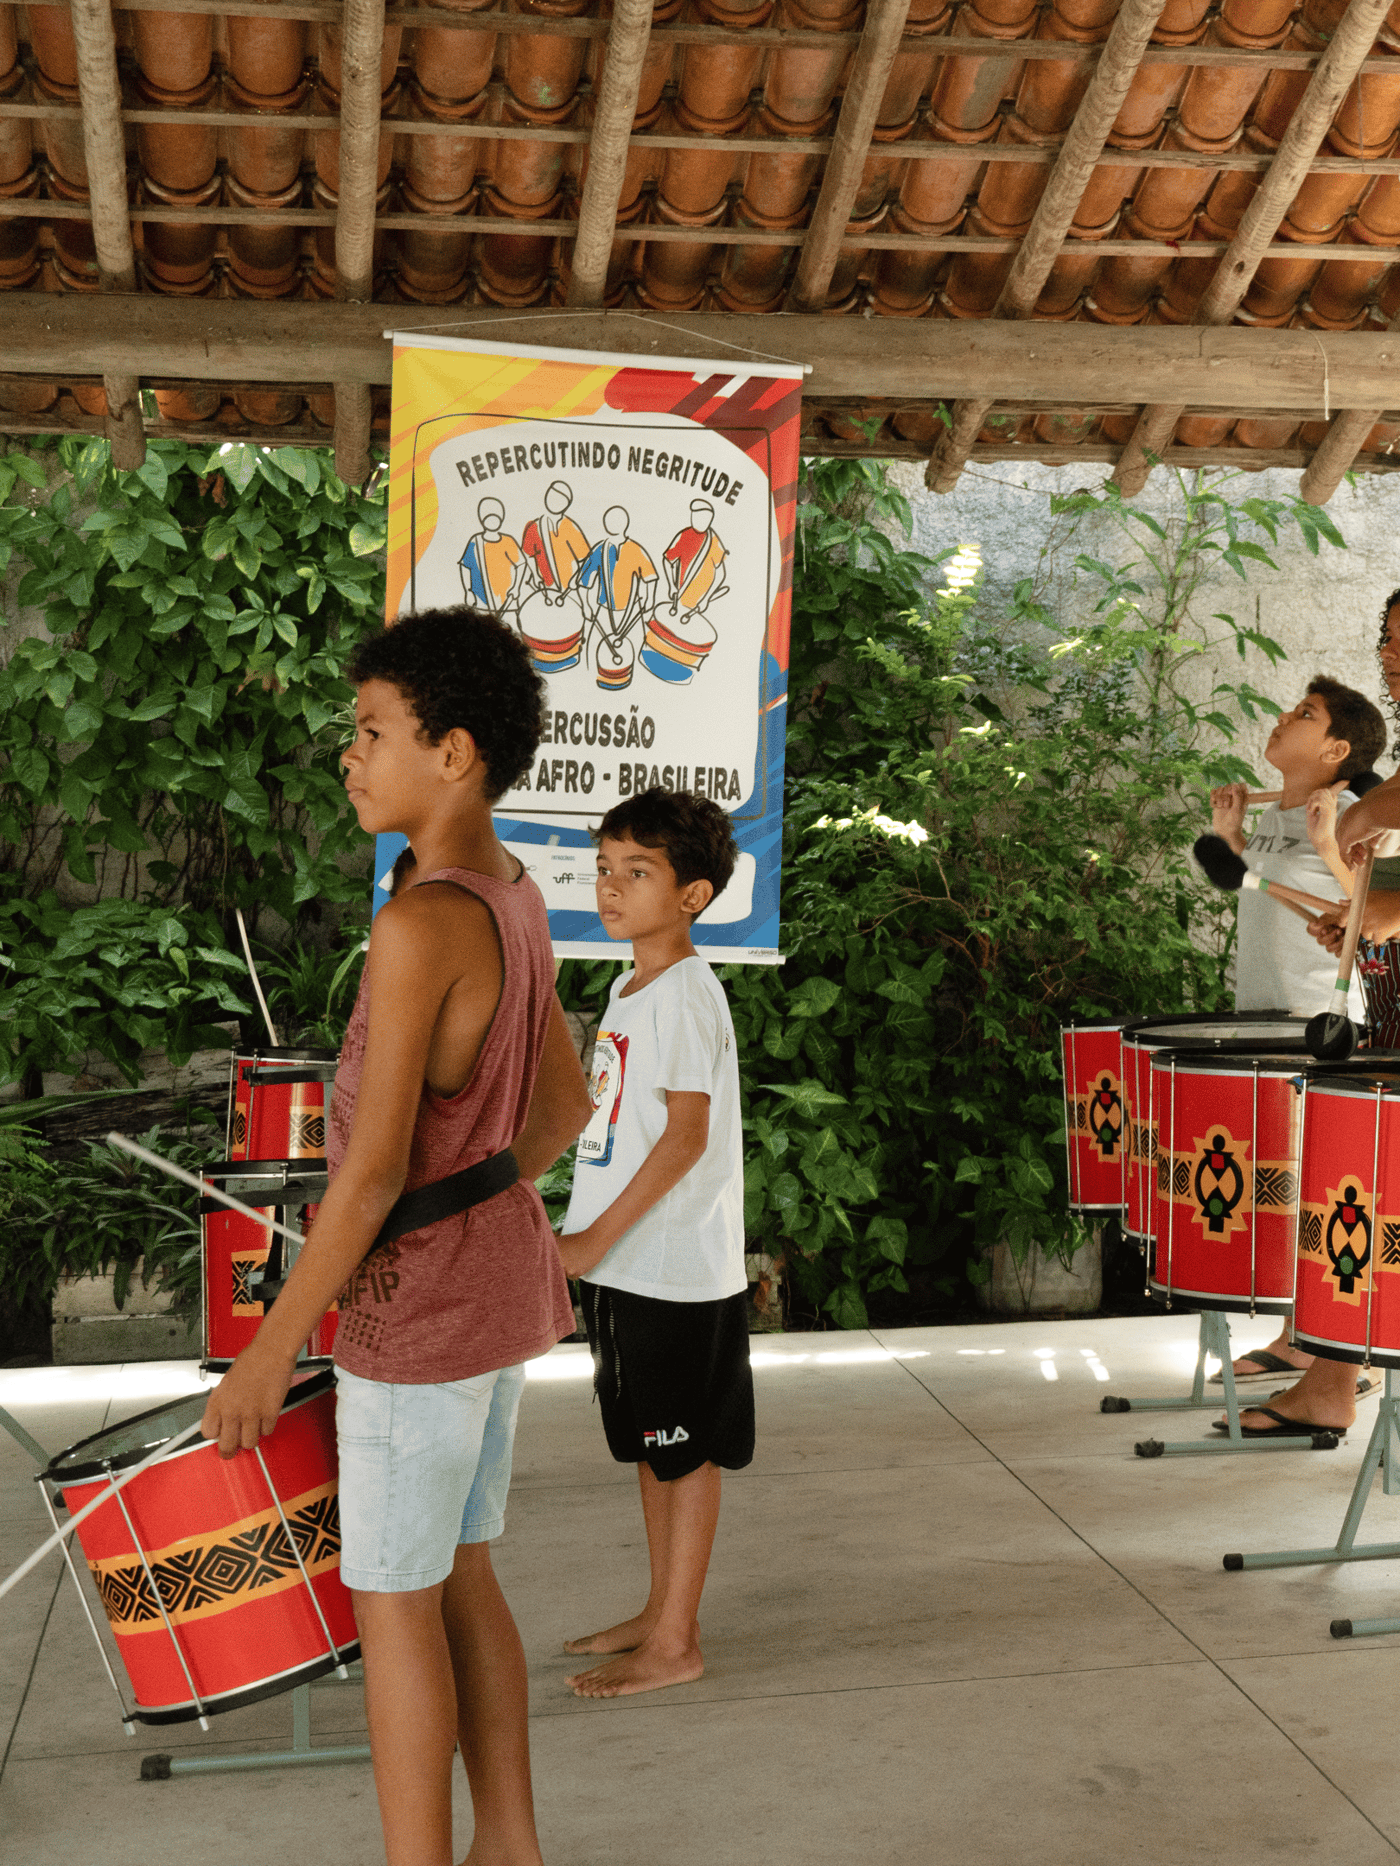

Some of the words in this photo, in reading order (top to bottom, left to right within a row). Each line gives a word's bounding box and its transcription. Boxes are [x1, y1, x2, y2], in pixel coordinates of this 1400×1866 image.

[456, 441, 620, 487] REPERCUTINDO
[628, 446, 743, 506] NEGRITUDE
[539, 704, 655, 749] ERCUSSÃO
[536, 758, 595, 794] AFRO
[618, 763, 741, 801] BRASILEIRA
[644, 1425, 689, 1447] FILA
